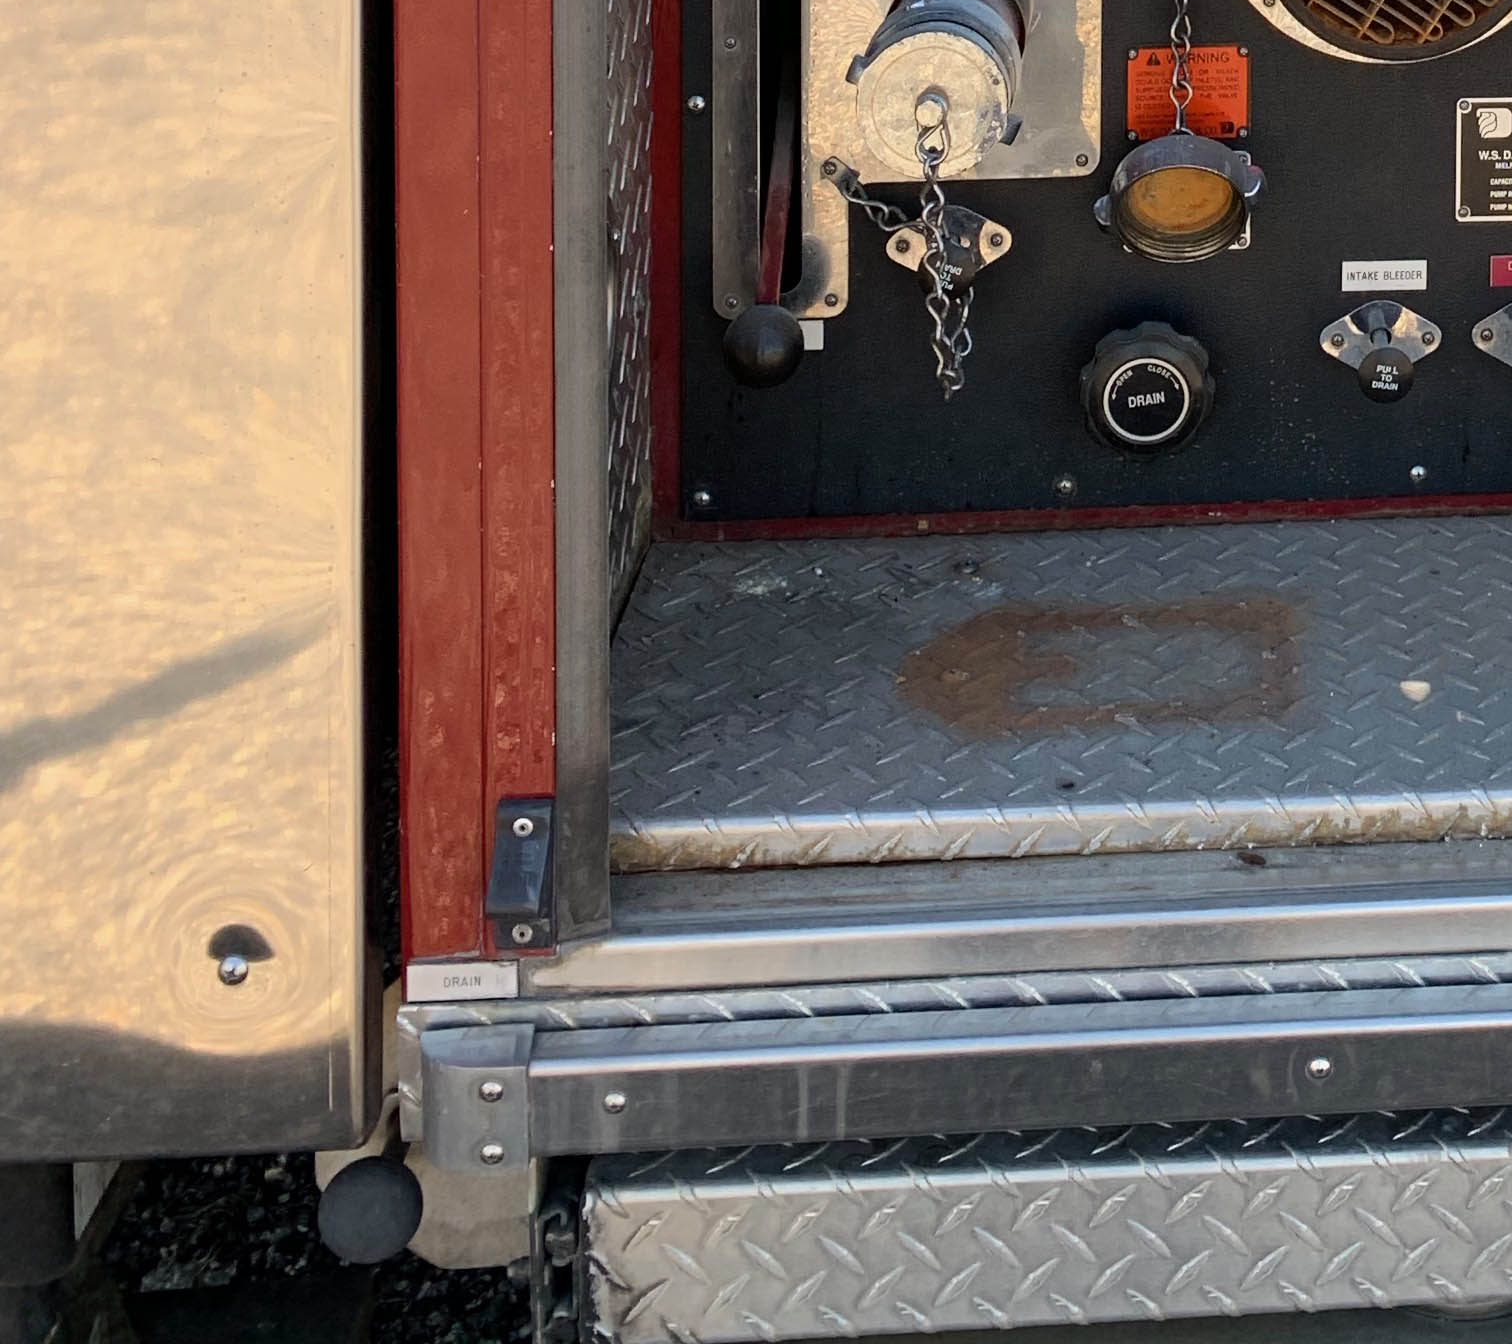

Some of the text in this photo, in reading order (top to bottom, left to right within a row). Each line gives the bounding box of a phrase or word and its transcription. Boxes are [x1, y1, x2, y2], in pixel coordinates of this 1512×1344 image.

[1166, 52, 1230, 65] WRNING
[1478, 149, 1502, 161] W.S.
[1346, 270, 1424, 282] INTAKE BLEEDER
[1371, 381, 1399, 391] DRAIN
[1127, 391, 1166, 409] DRAIN
[443, 975, 482, 988] DRAIN
